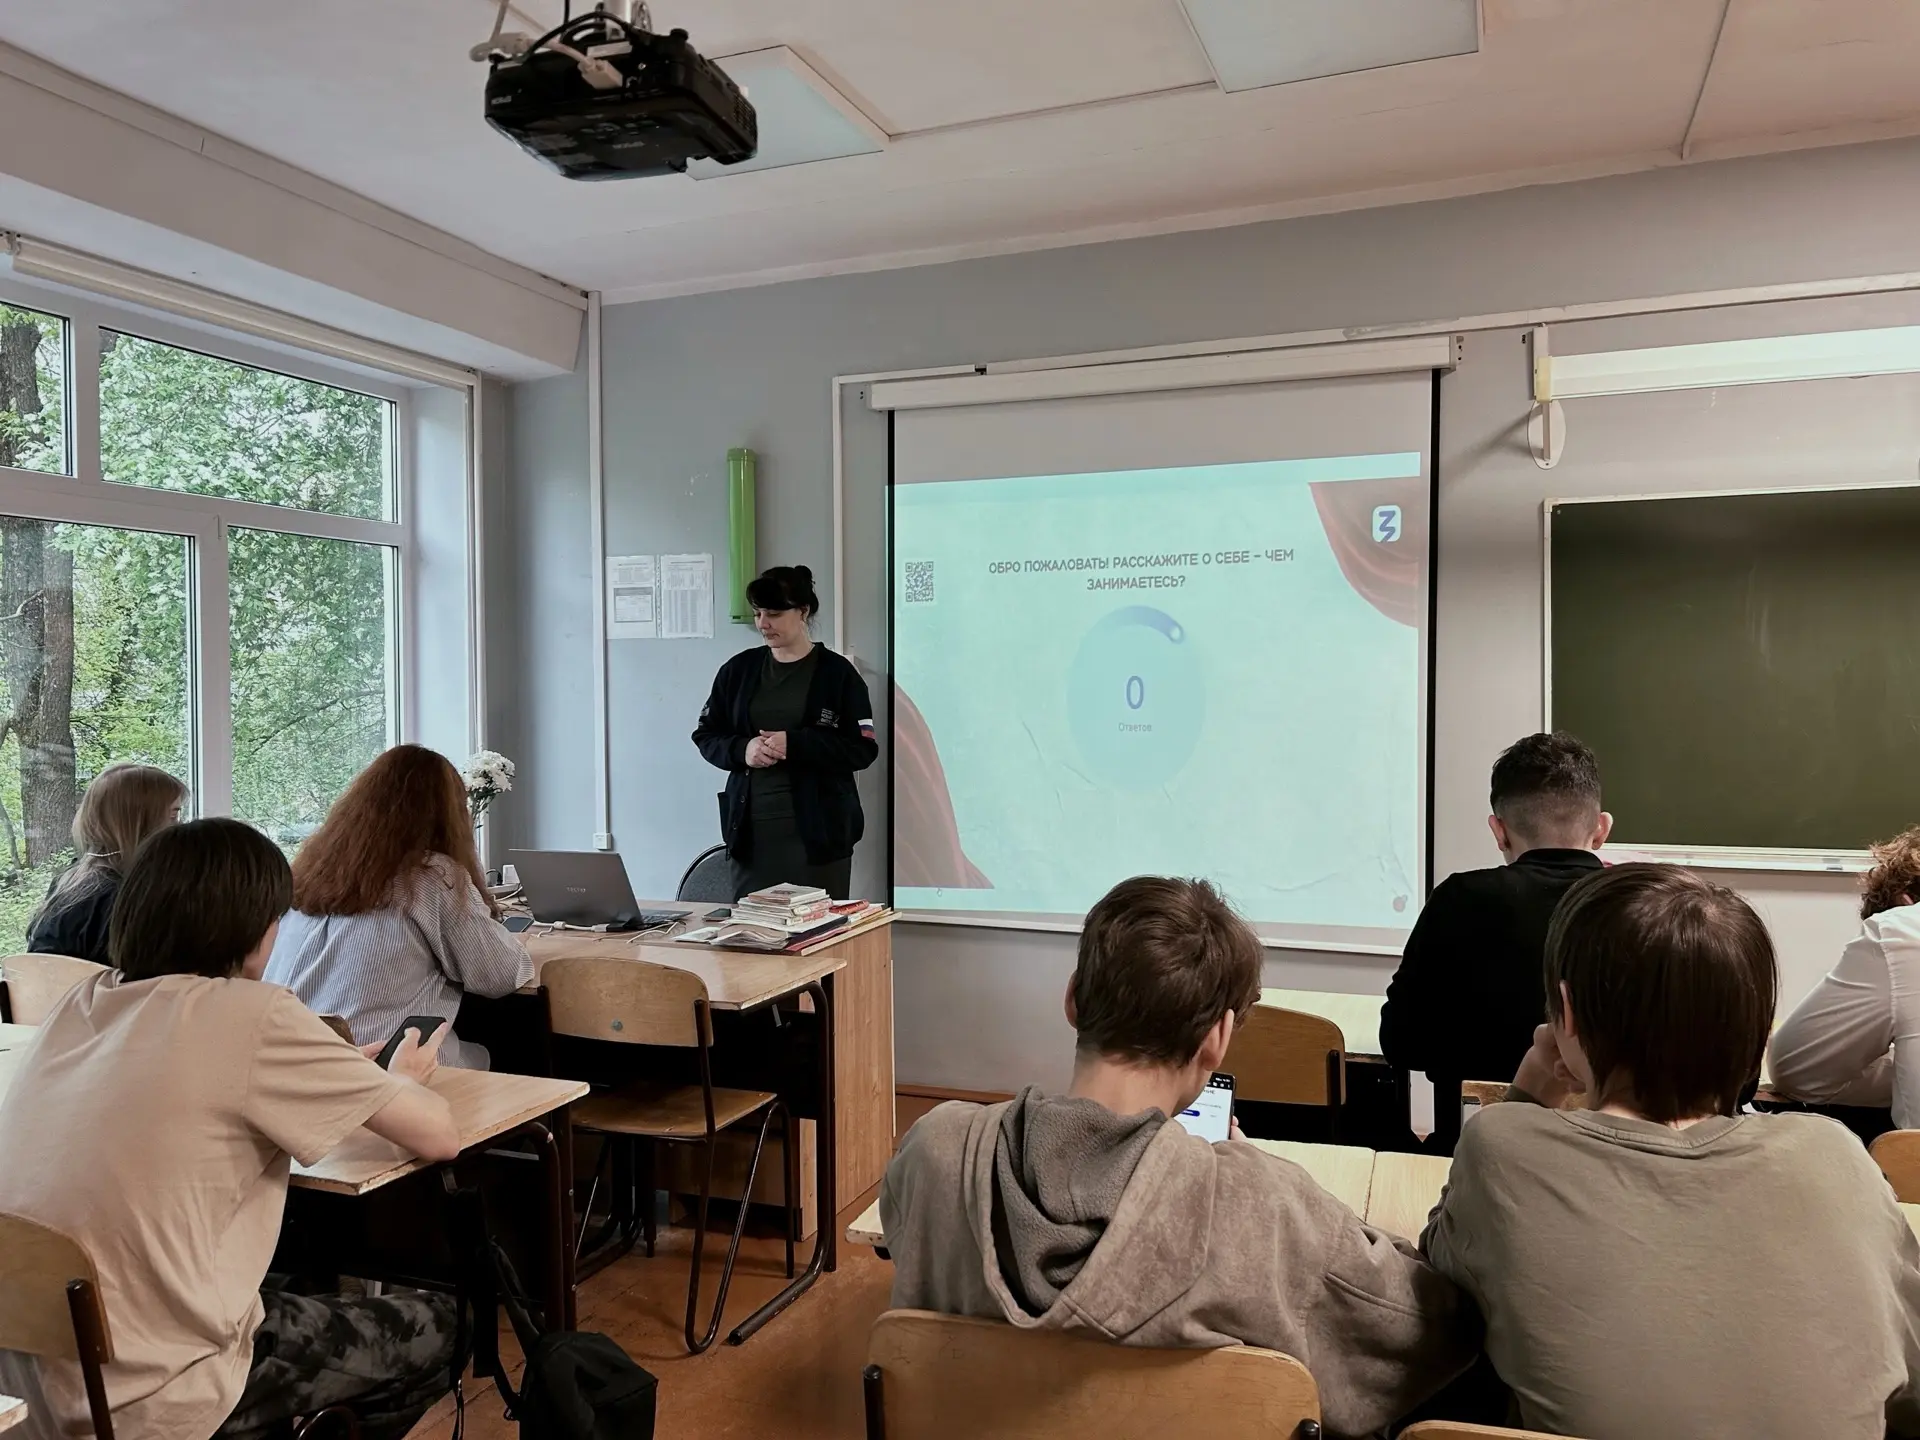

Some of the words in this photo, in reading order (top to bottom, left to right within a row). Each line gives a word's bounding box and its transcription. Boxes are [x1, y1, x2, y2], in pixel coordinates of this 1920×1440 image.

[989, 561, 1021, 574] ОБРО
[1024, 557, 1109, 573] ПОЖАЛОВАТЬ!
[1113, 553, 1198, 568] РАССКАЖИТЕ
[1202, 553, 1211, 565] О
[1215, 550, 1250, 564] СЕБЕ
[1265, 549, 1294, 562] ЧЕМ
[1087, 575, 1186, 590] ЗАНИМАЕТЕСЬ?
[1118, 722, 1152, 732] Ответов
